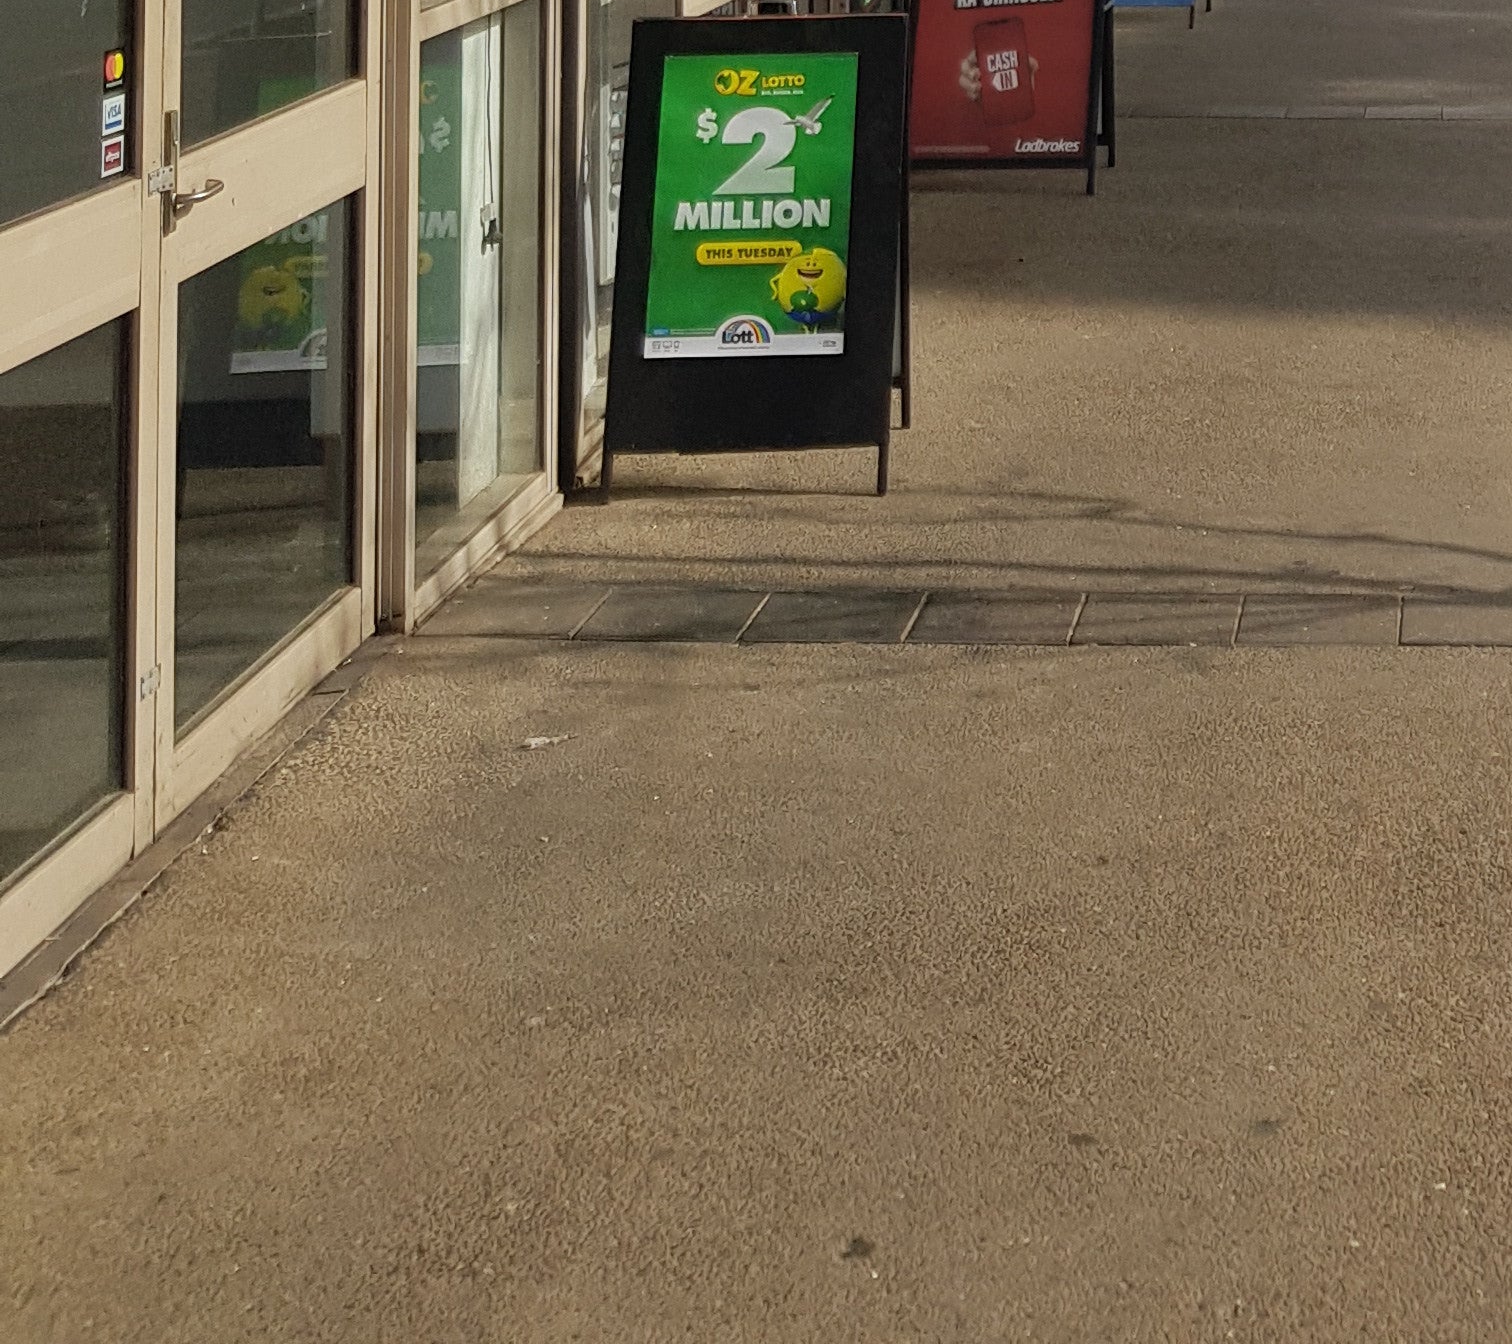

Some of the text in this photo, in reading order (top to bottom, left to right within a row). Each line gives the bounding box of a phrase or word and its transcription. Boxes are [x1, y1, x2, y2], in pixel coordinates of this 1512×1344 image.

[986, 50, 1019, 72] CASH
[714, 69, 805, 97] OZ LOTTO
[1000, 74, 1014, 89] IN
[1014, 139, 1080, 153] Ladbrokes
[673, 198, 831, 231] MILLION
[706, 246, 793, 260] THIS TUESDAY
